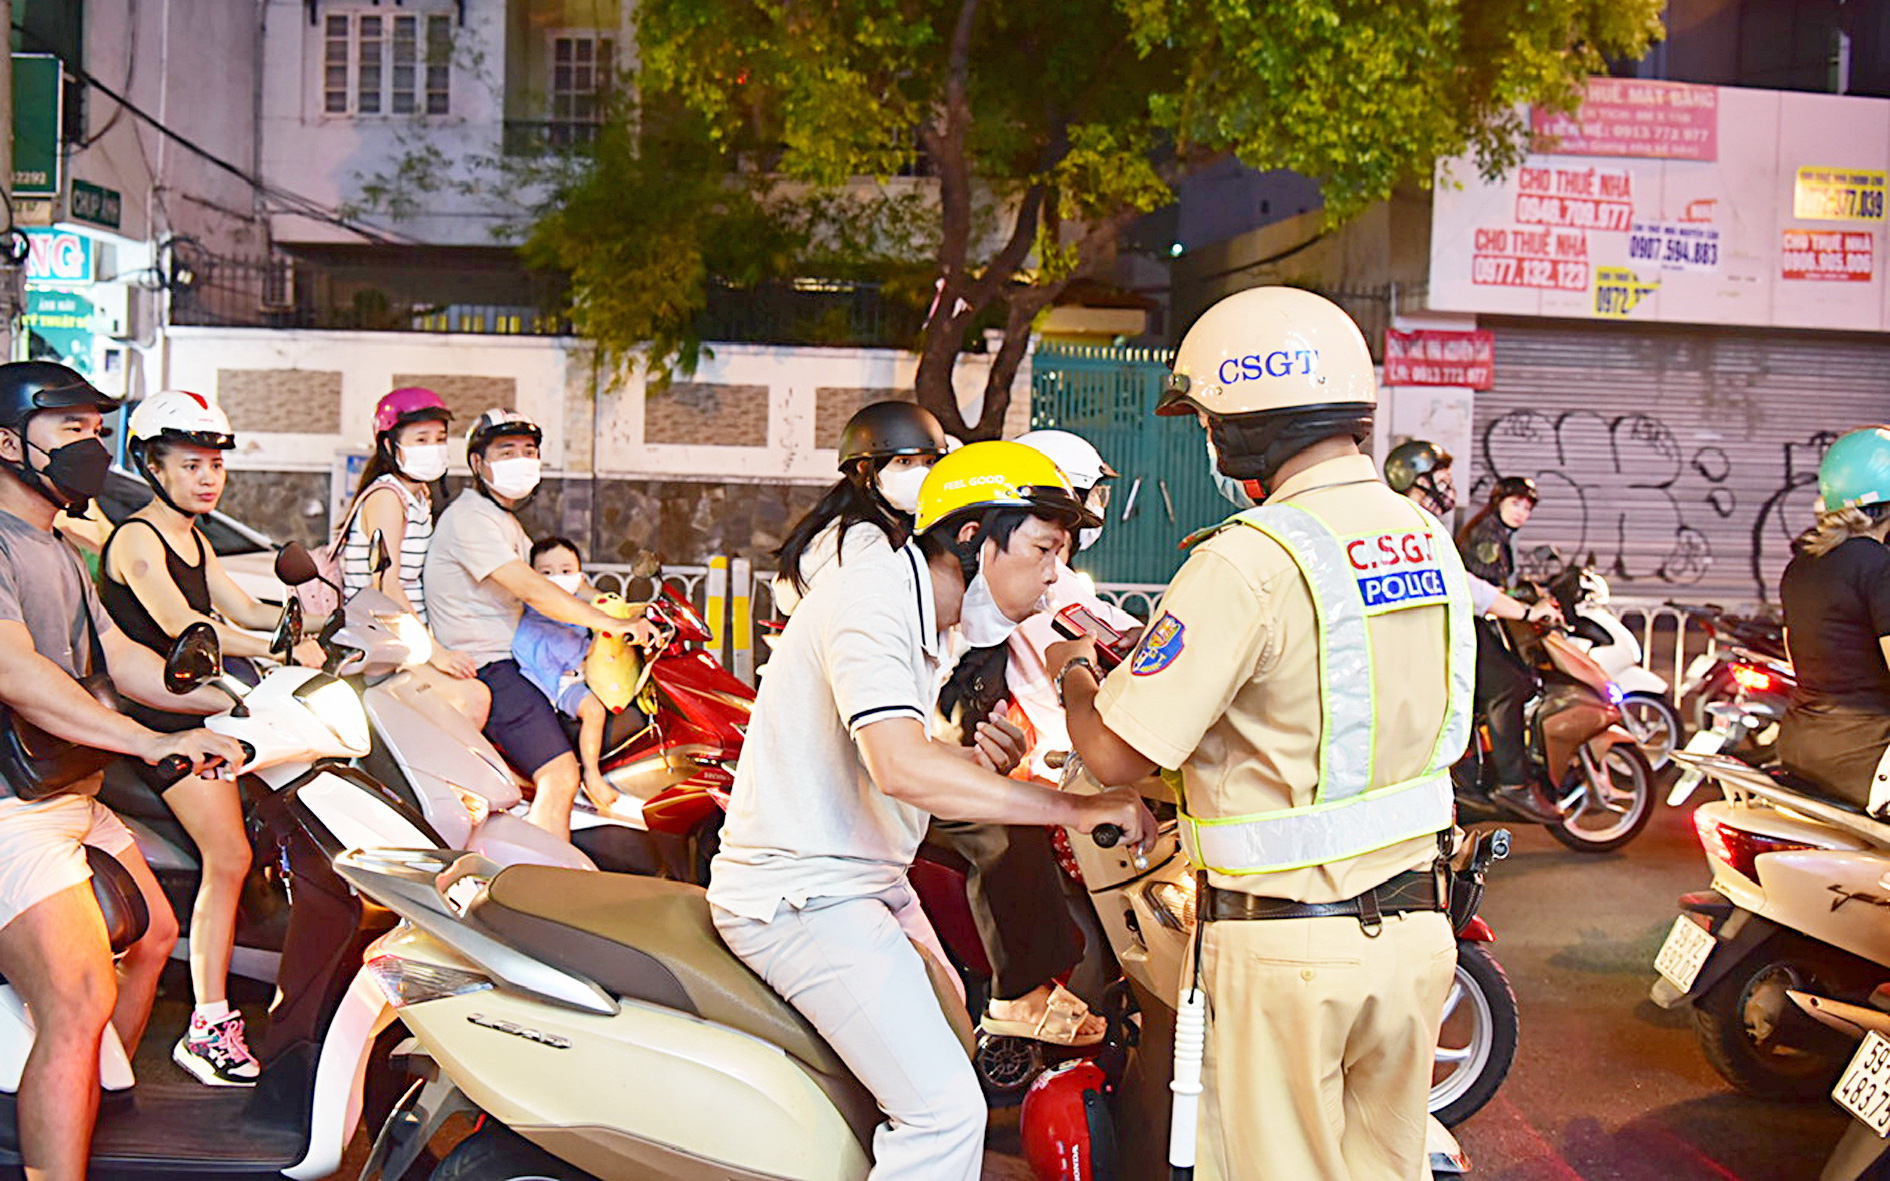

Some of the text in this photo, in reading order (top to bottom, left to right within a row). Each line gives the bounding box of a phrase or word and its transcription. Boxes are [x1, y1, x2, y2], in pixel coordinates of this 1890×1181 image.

[1519, 166, 1551, 192] CHO
[1475, 228, 1507, 251] CHO
[1219, 349, 1319, 385] CSGT
[944, 479, 967, 491] FEEL
[1365, 571, 1443, 604] POLICE
[467, 1012, 571, 1049] LEAD
